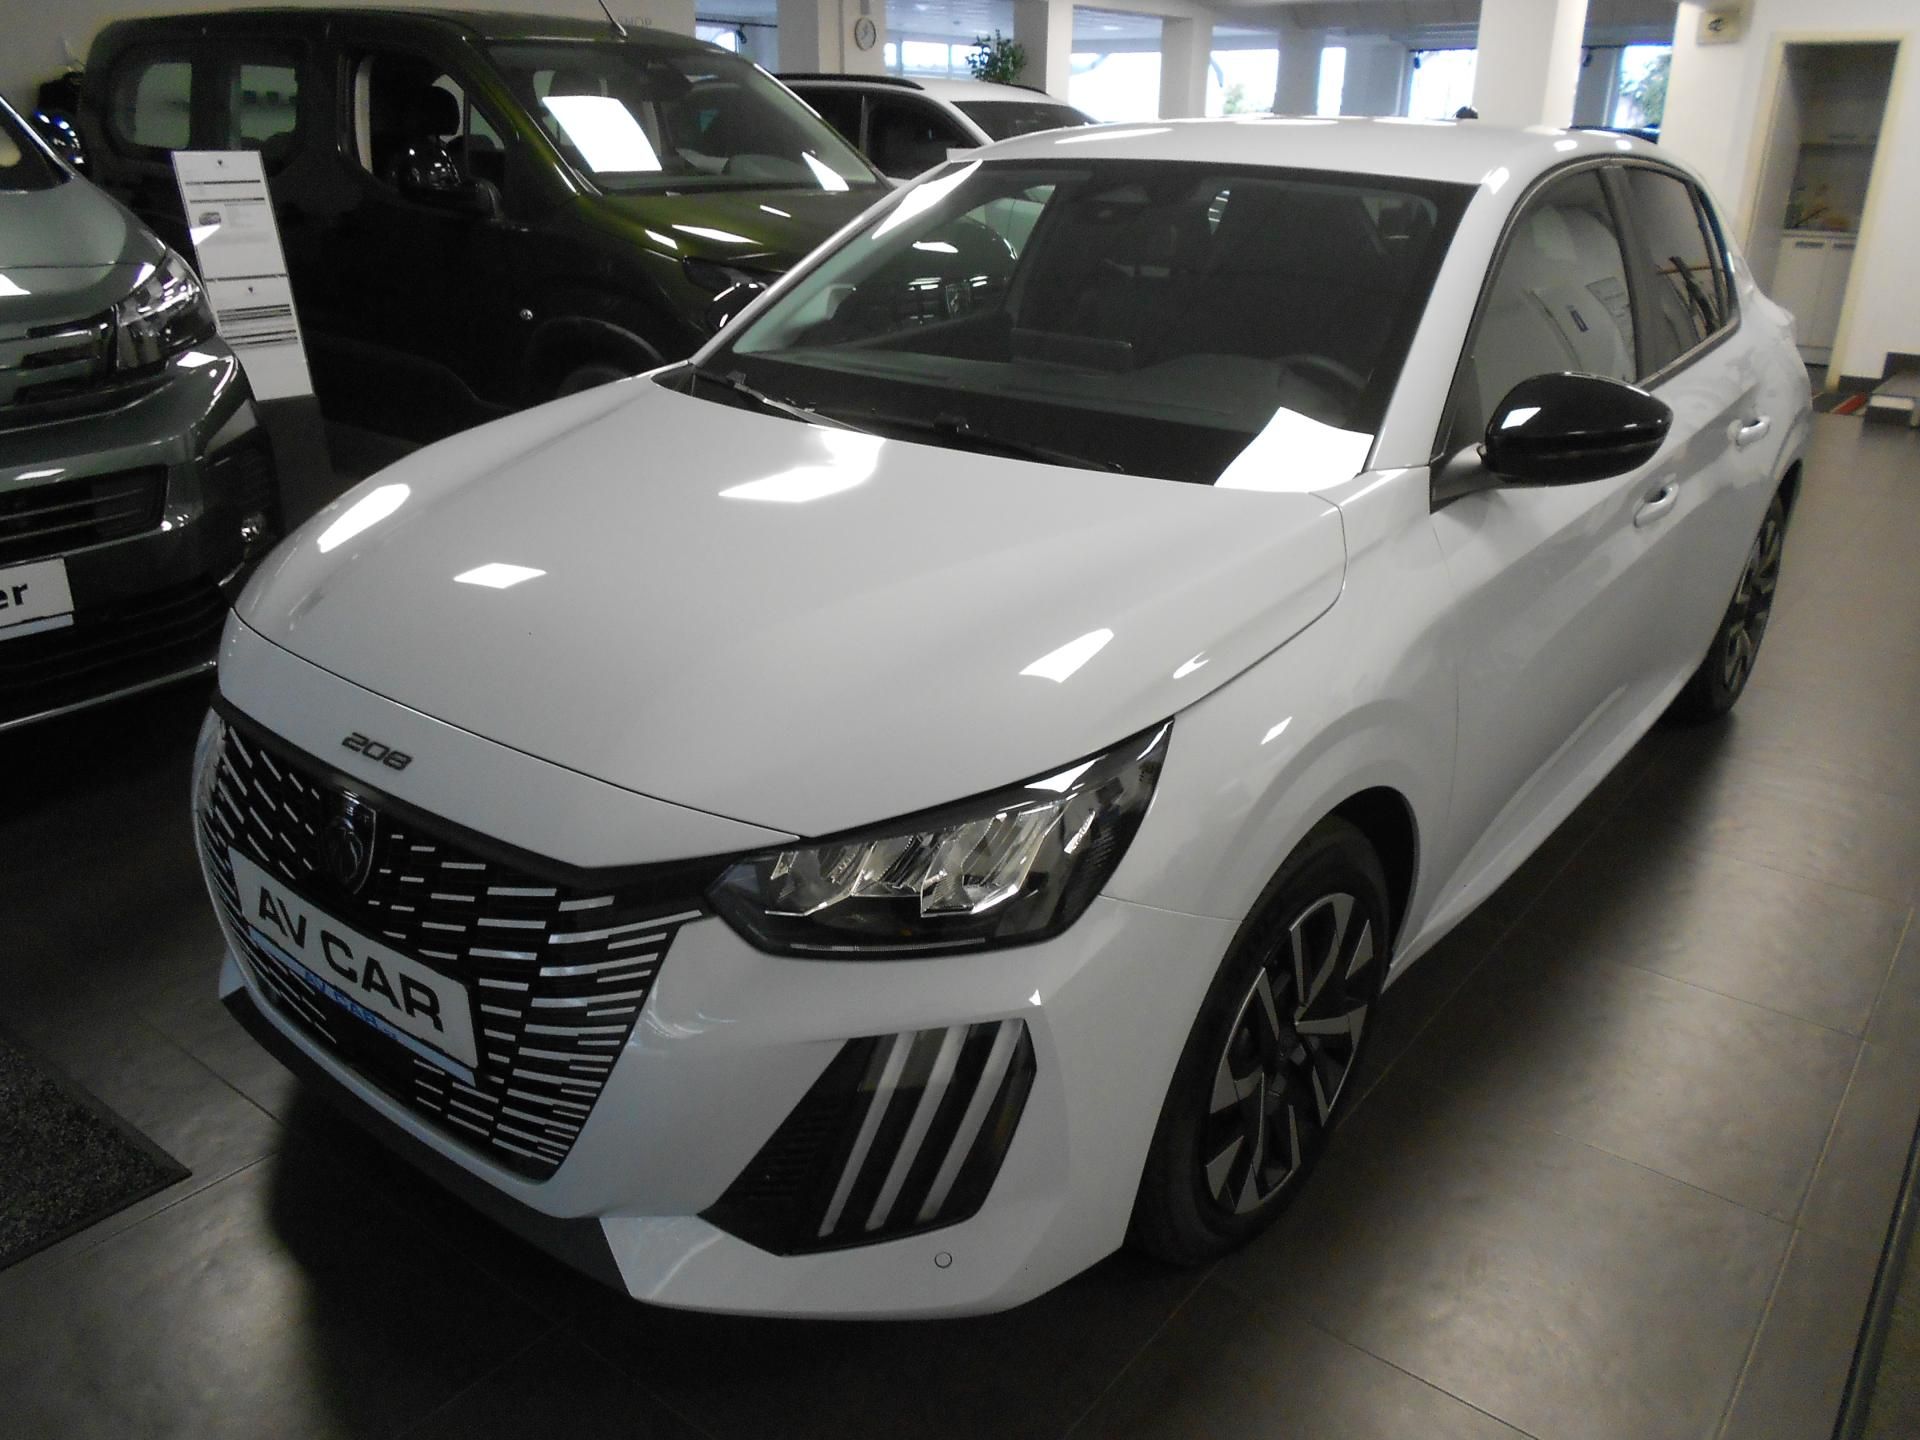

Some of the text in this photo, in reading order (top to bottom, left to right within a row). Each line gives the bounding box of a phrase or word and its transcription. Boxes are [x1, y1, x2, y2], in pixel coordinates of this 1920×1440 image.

[342, 732, 413, 771] 208
[259, 886, 444, 1033] AV CAR
